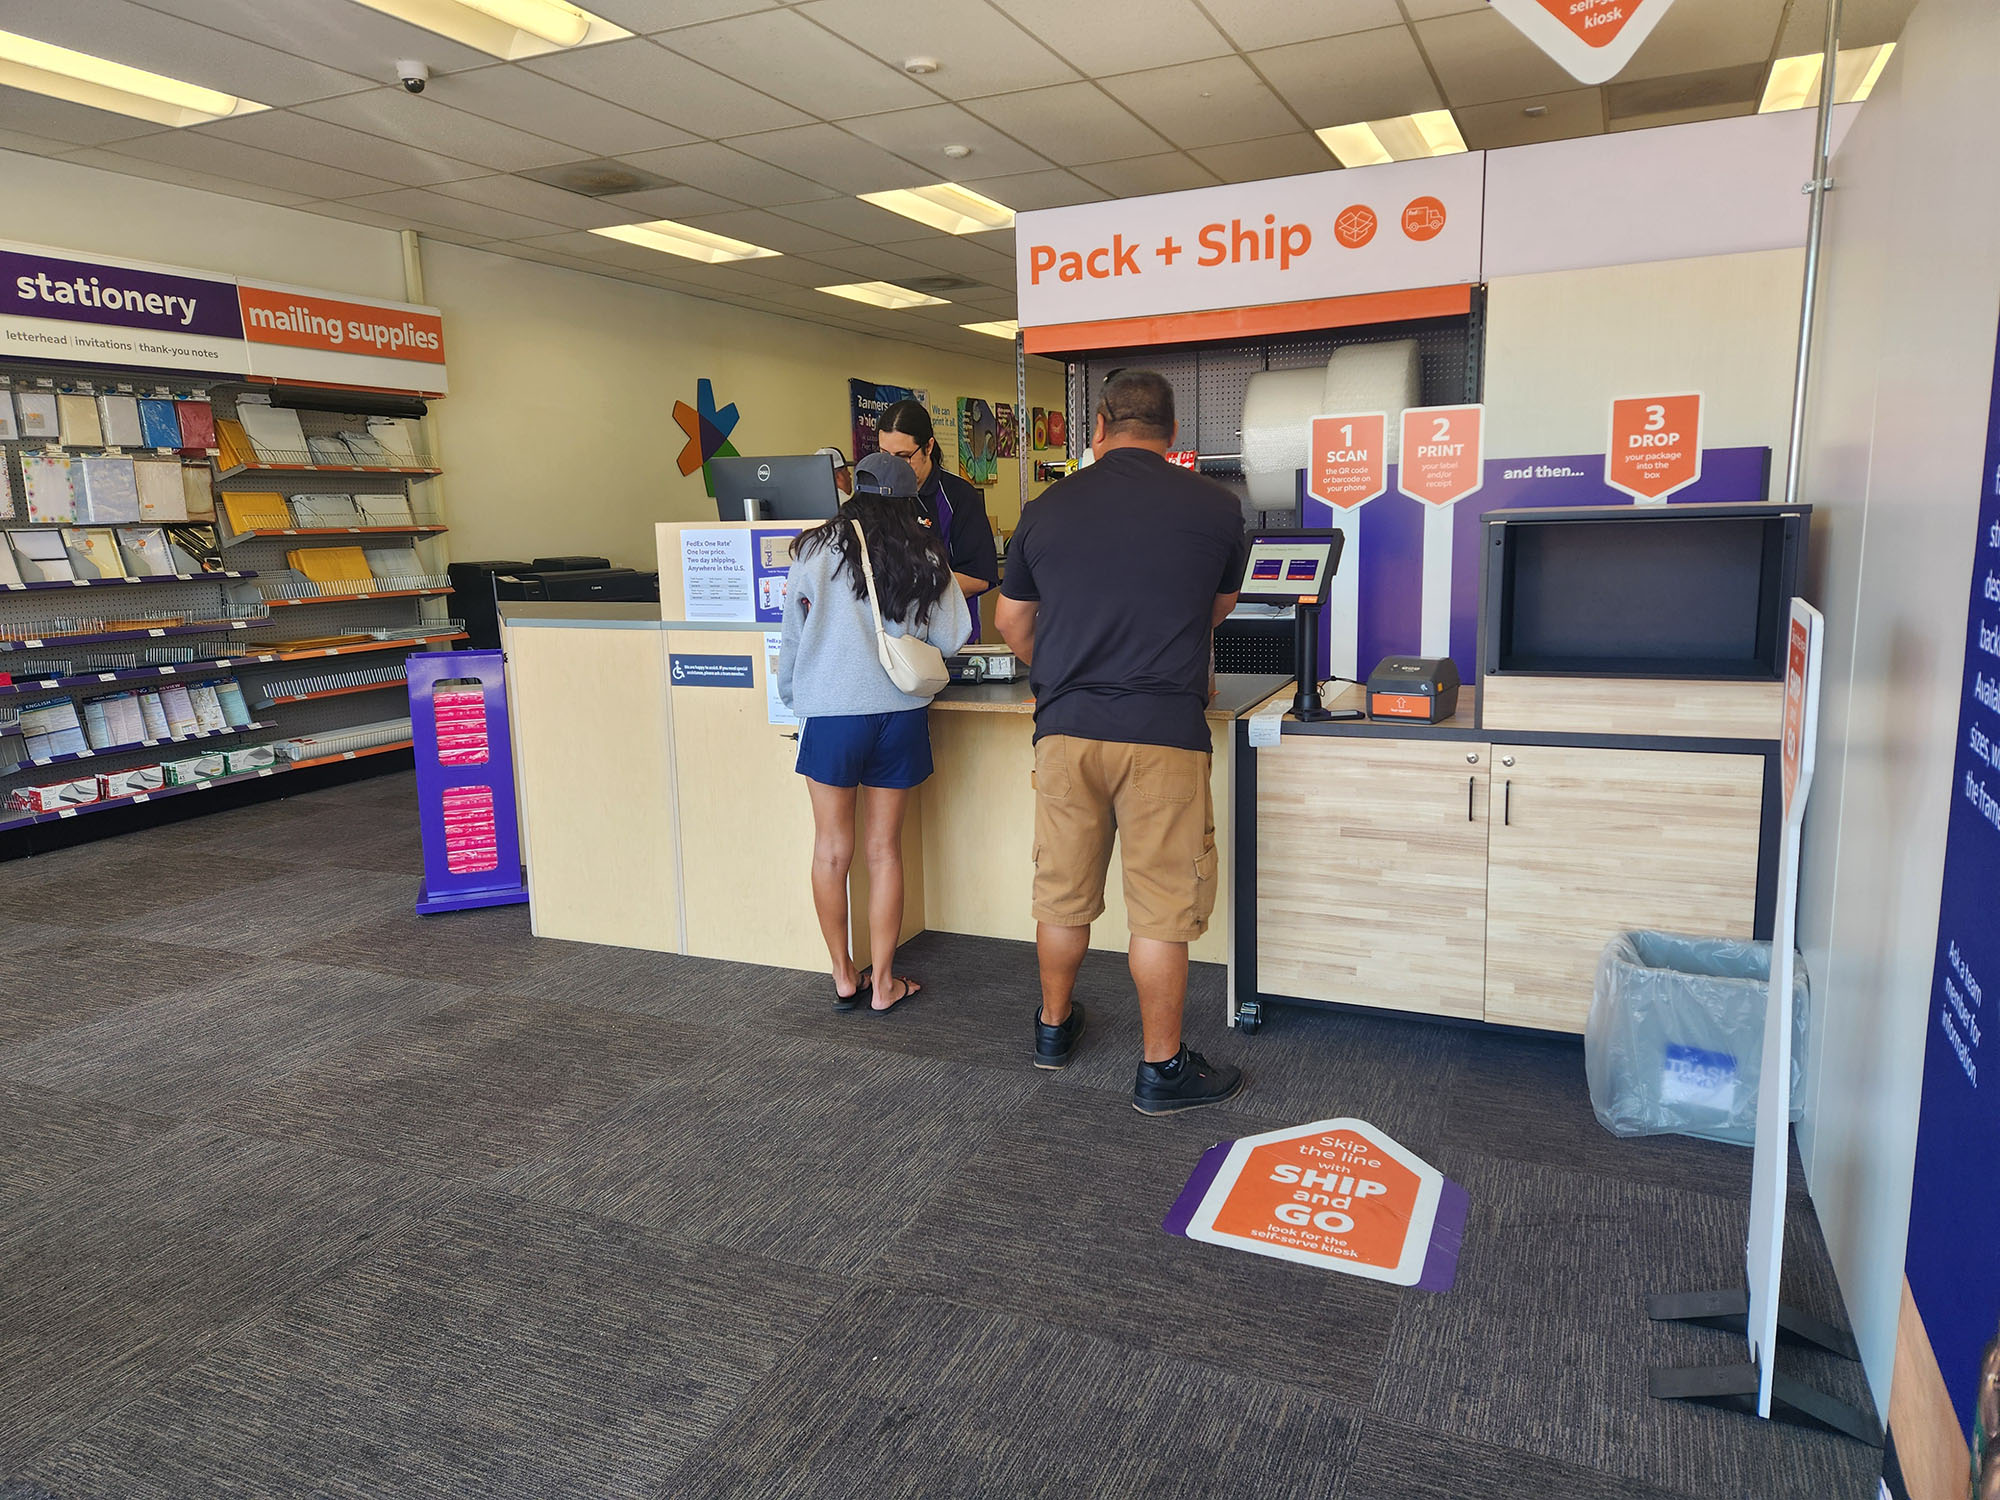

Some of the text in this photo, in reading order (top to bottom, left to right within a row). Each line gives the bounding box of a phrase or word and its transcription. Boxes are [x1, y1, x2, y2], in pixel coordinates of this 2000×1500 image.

[1584, 7, 1623, 29] kiosk
[1030, 213, 1312, 285] Pack + Ship
[16, 272, 197, 326] stationery
[248, 305, 440, 351] mailing supplies
[6, 330, 219, 359] letterhead invitations thank-you notes
[932, 404, 951, 416] We can
[1643, 404, 1666, 431] 3
[1340, 424, 1353, 448] 1
[1431, 417, 1450, 442] 2
[1628, 432, 1680, 448] DROP
[1327, 449, 1368, 464] SCAN
[1417, 444, 1465, 458] PRINT
[1625, 451, 1682, 463] your package
[1325, 466, 1369, 475] the QR code
[1421, 461, 1459, 471] your label
[1426, 471, 1452, 479] and/or
[1503, 464, 1585, 480] and then...
[1636, 461, 1669, 470] into the
[1644, 470, 1660, 479] box
[1322, 476, 1331, 484] or
[1331, 475, 1361, 484] barcode
[1326, 484, 1367, 493] your phone
[1425, 480, 1452, 488] receipt
[700, 557, 710, 565] day
[711, 557, 737, 565] shipping.
[710, 548, 726, 556] price.
[688, 565, 716, 573] Anywhere
[1979, 618, 2000, 657] back
[25, 700, 52, 710] ENGLISH
[1969, 721, 1990, 767] sizes,
[1966, 769, 1979, 806] the
[1948, 939, 1982, 1008] Ask a team
[1945, 976, 1981, 1049] member for
[1942, 1002, 1978, 1089] information.
[1319, 1136, 1368, 1154] Skip
[1299, 1144, 1382, 1168] the line
[1318, 1161, 1351, 1174] with
[1269, 1164, 1387, 1199] SHIP
[1292, 1189, 1352, 1210] and
[1274, 1203, 1355, 1233] GO
[1250, 1229, 1359, 1258] self-serve kiosk
[1267, 1223, 1348, 1247] look for the
